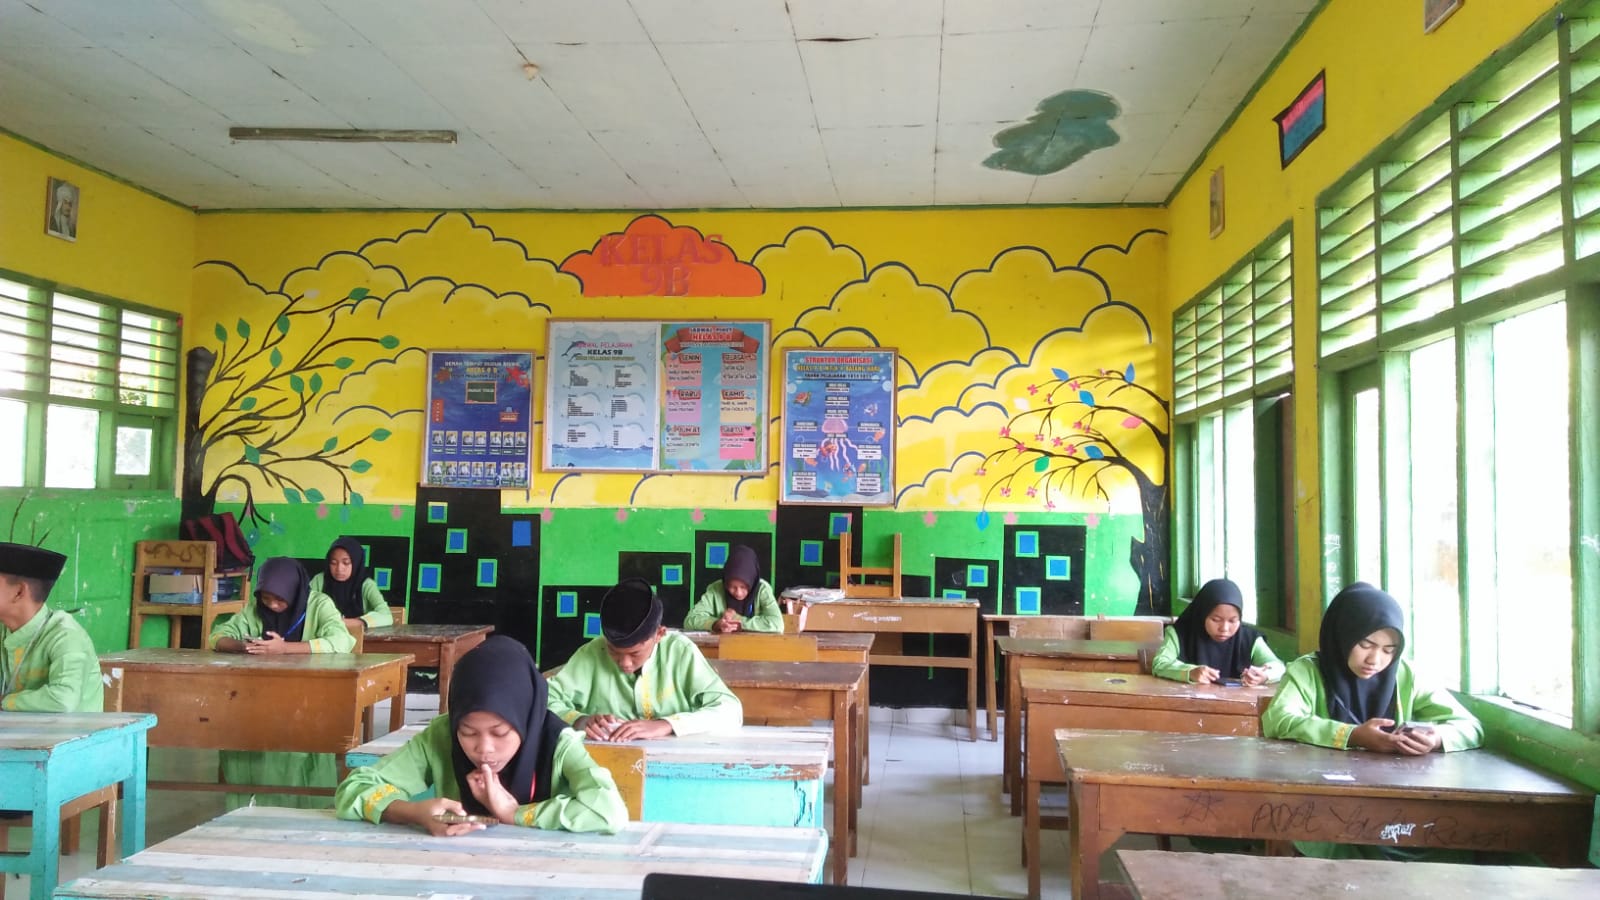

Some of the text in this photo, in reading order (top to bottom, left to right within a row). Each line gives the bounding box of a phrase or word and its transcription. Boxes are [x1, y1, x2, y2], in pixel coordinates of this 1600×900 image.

[600, 233, 723, 266] KELAS
[640, 264, 690, 297] 9B
[724, 389, 745, 397] KAMIS
